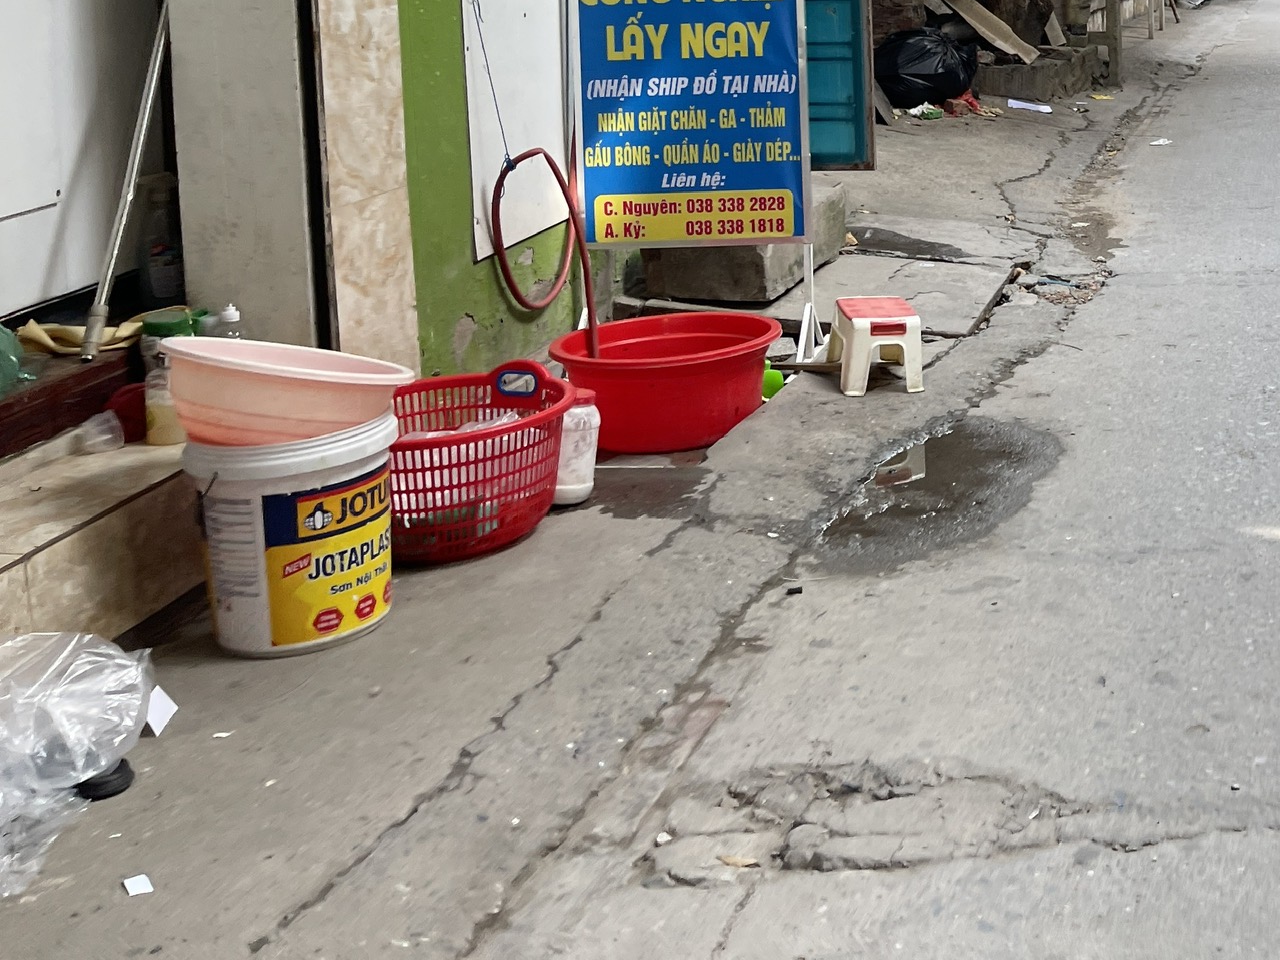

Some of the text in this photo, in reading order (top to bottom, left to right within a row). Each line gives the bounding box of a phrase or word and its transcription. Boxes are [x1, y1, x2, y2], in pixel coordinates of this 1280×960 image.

[606, 11, 770, 61] LẤY NGAY
[587, 75, 643, 101] (NHẬN
[647, 77, 689, 96] SHIP
[722, 75, 750, 98] TẠI
[753, 69, 797, 95] NHÀ)
[598, 107, 635, 136] NHẬN
[638, 107, 667, 135] GIẶT
[670, 105, 707, 130] CHĂN
[719, 109, 737, 129] GA
[749, 101, 786, 127] THẢM
[585, 140, 611, 167] GẤU
[615, 142, 651, 166] BÔNG
[663, 138, 699, 167] QUẦN
[702, 140, 720, 164] ÁO
[661, 172, 727, 190] Liên hệ:
[604, 196, 786, 217] C. Nguyên: 038 338 2828
[604, 223, 619, 239] A.
[685, 220, 713, 236] 038
[717, 219, 745, 235] 338
[749, 218, 785, 233] 1818
[284, 554, 311, 577] NEW
[330, 581, 353, 596] Sơn
[356, 573, 372, 589] Nội
